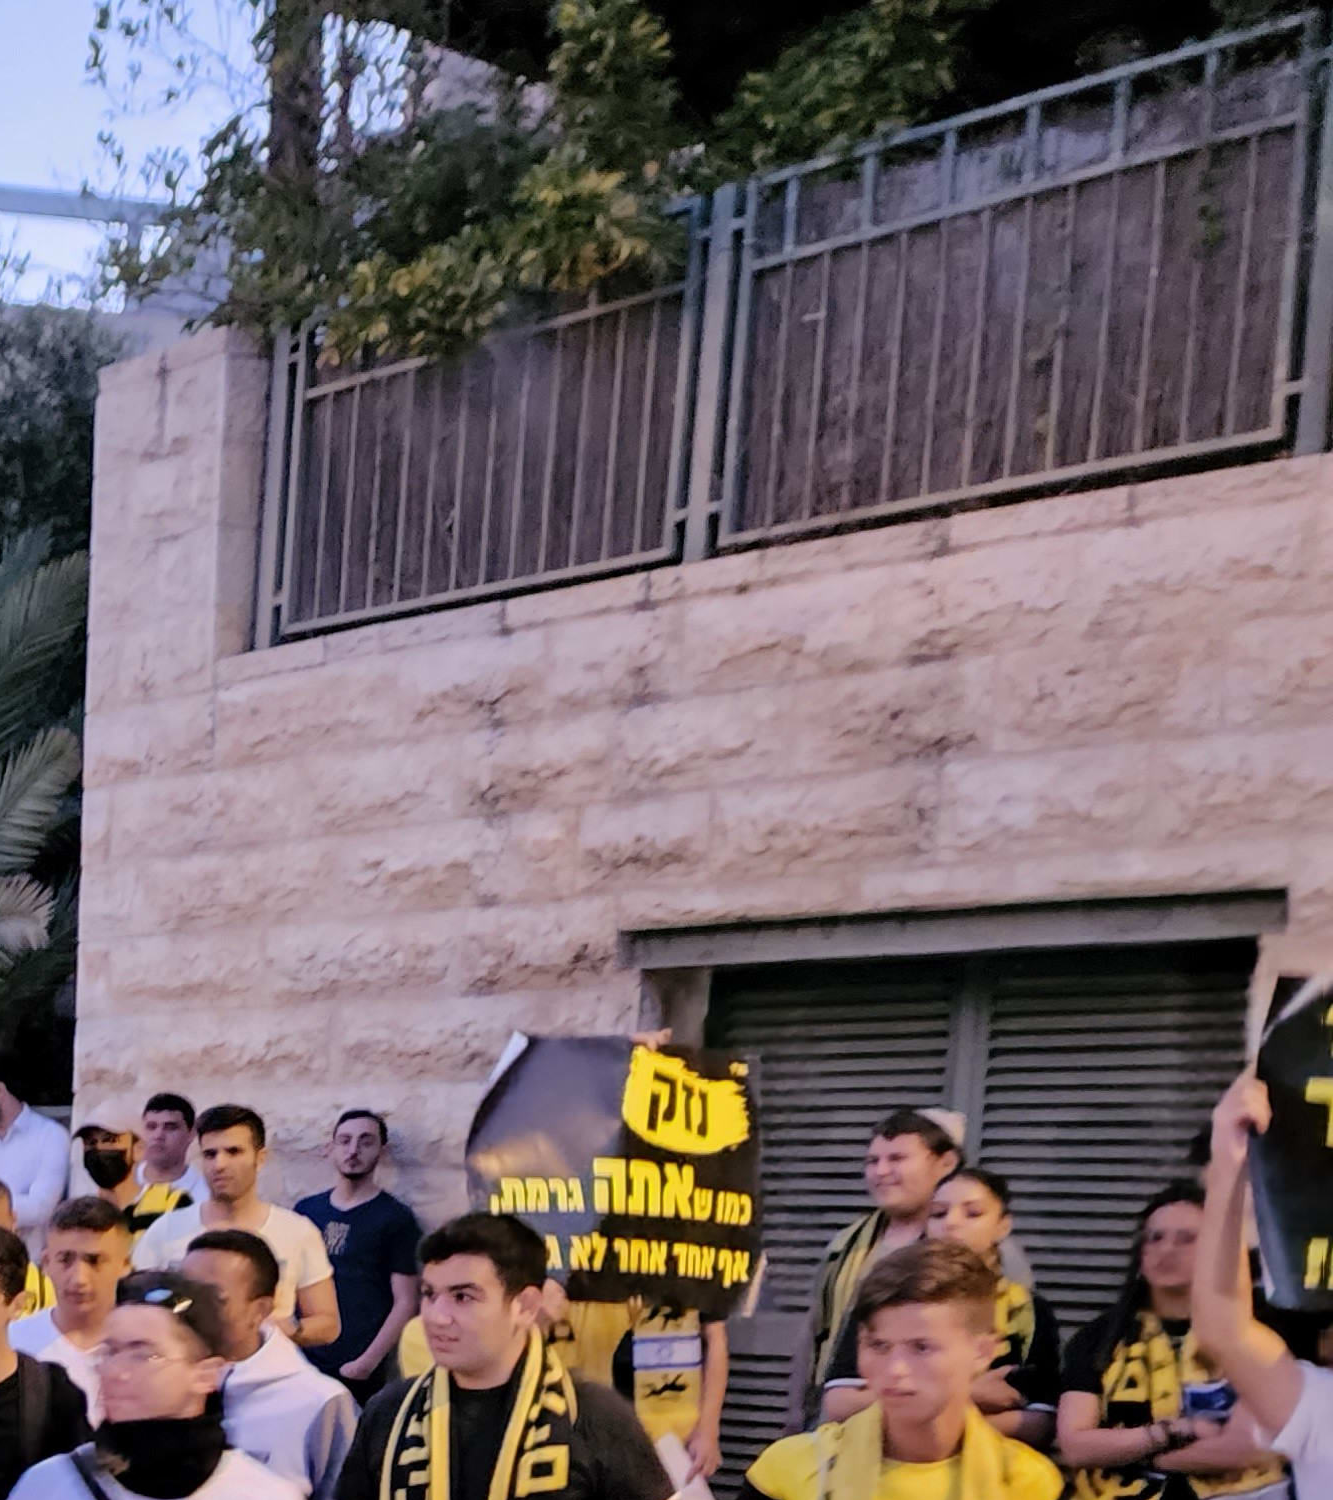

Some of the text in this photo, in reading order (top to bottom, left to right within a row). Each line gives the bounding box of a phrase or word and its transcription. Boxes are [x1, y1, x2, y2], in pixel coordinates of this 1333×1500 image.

[647, 1069, 708, 1139] נזק
[716, 1190, 753, 1226] כמו
[569, 1231, 608, 1272] לא
[613, 1237, 667, 1275] אחר
[672, 1242, 716, 1280] אחד
[718, 1248, 750, 1288] אף
